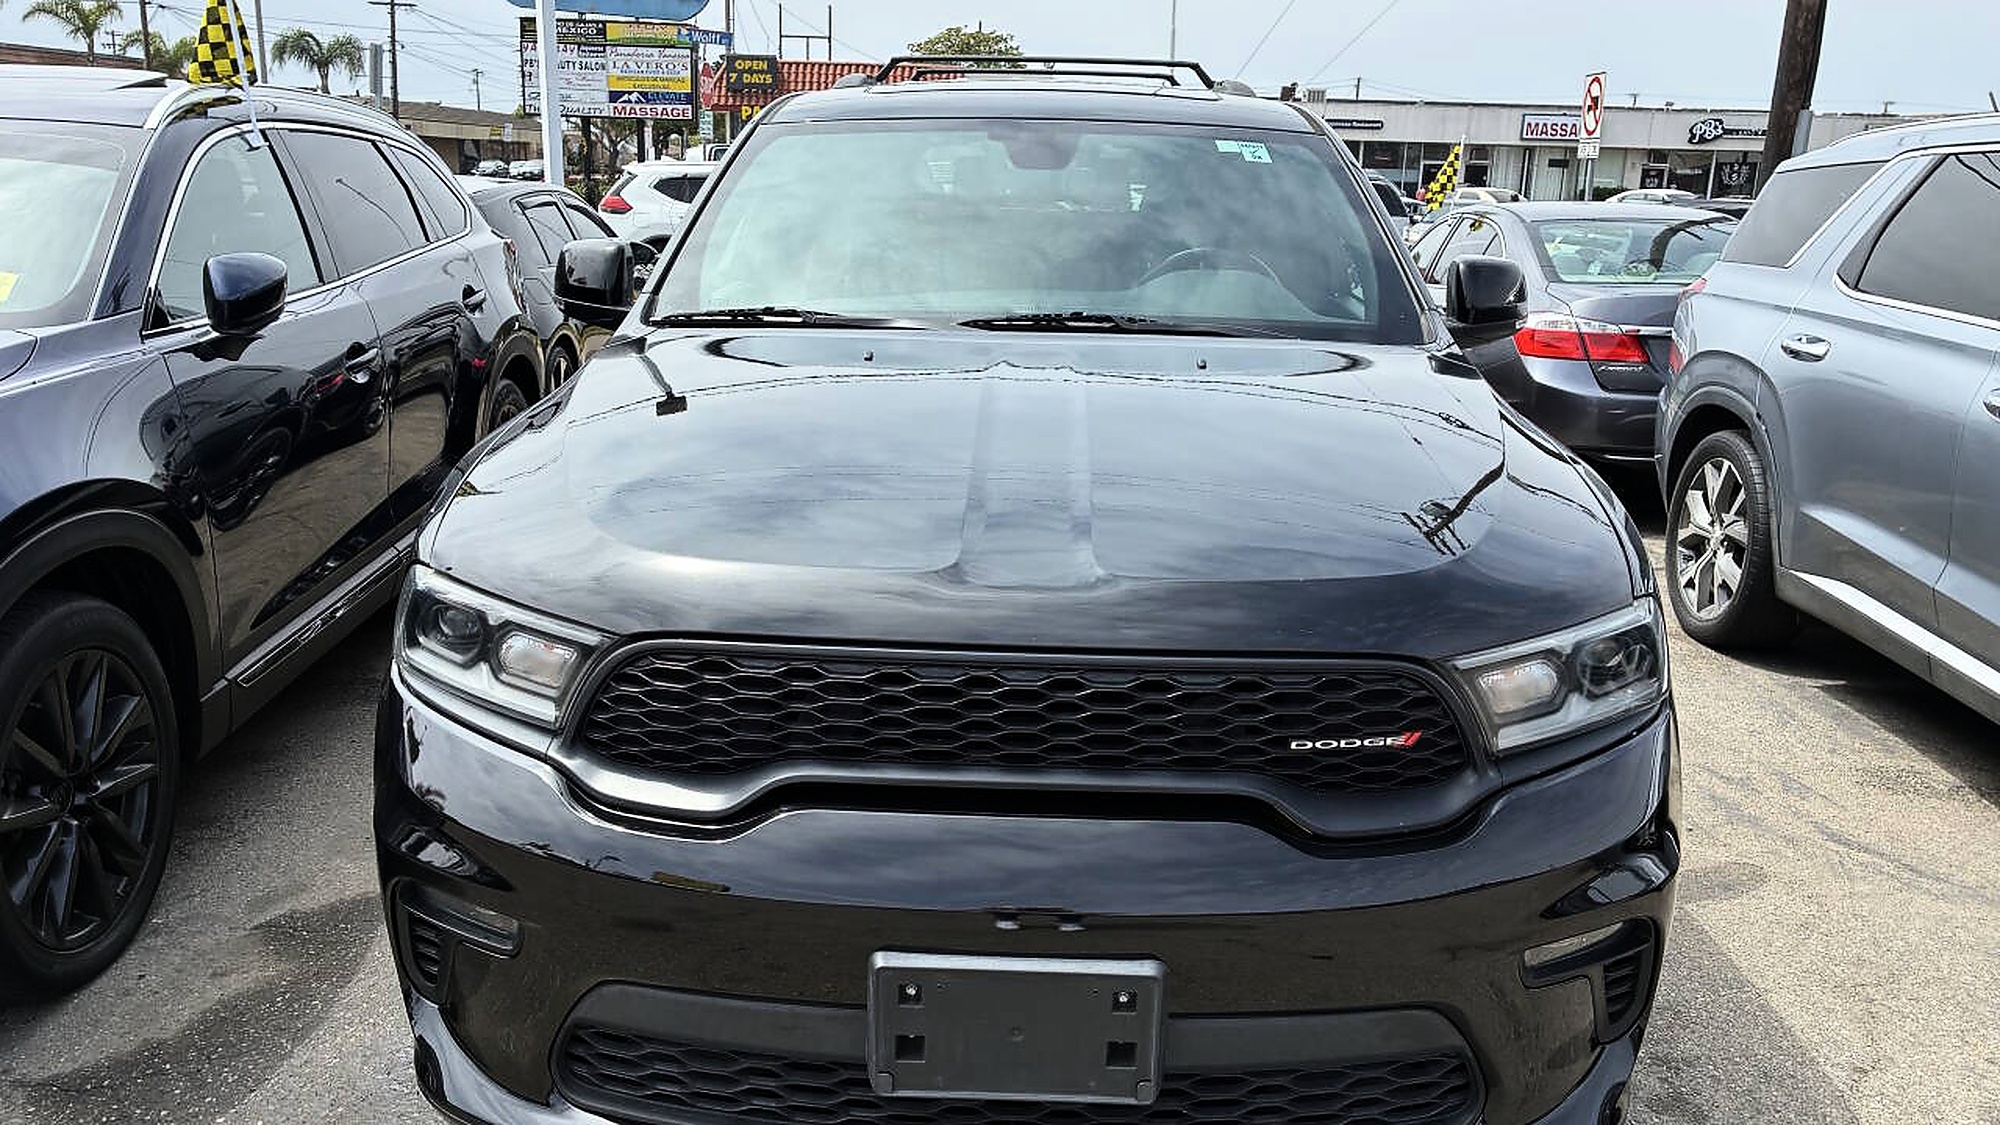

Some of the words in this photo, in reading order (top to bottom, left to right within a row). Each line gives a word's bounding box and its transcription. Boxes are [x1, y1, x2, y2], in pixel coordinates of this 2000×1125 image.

[734, 60, 768, 70] OPEN
[729, 73, 738, 83] 7
[742, 73, 774, 84] DAYS
[612, 105, 690, 118] MASSAGE
[741, 105, 761, 121] PA
[1525, 122, 1578, 138] MASSA
[1290, 735, 1406, 750] DODGE
